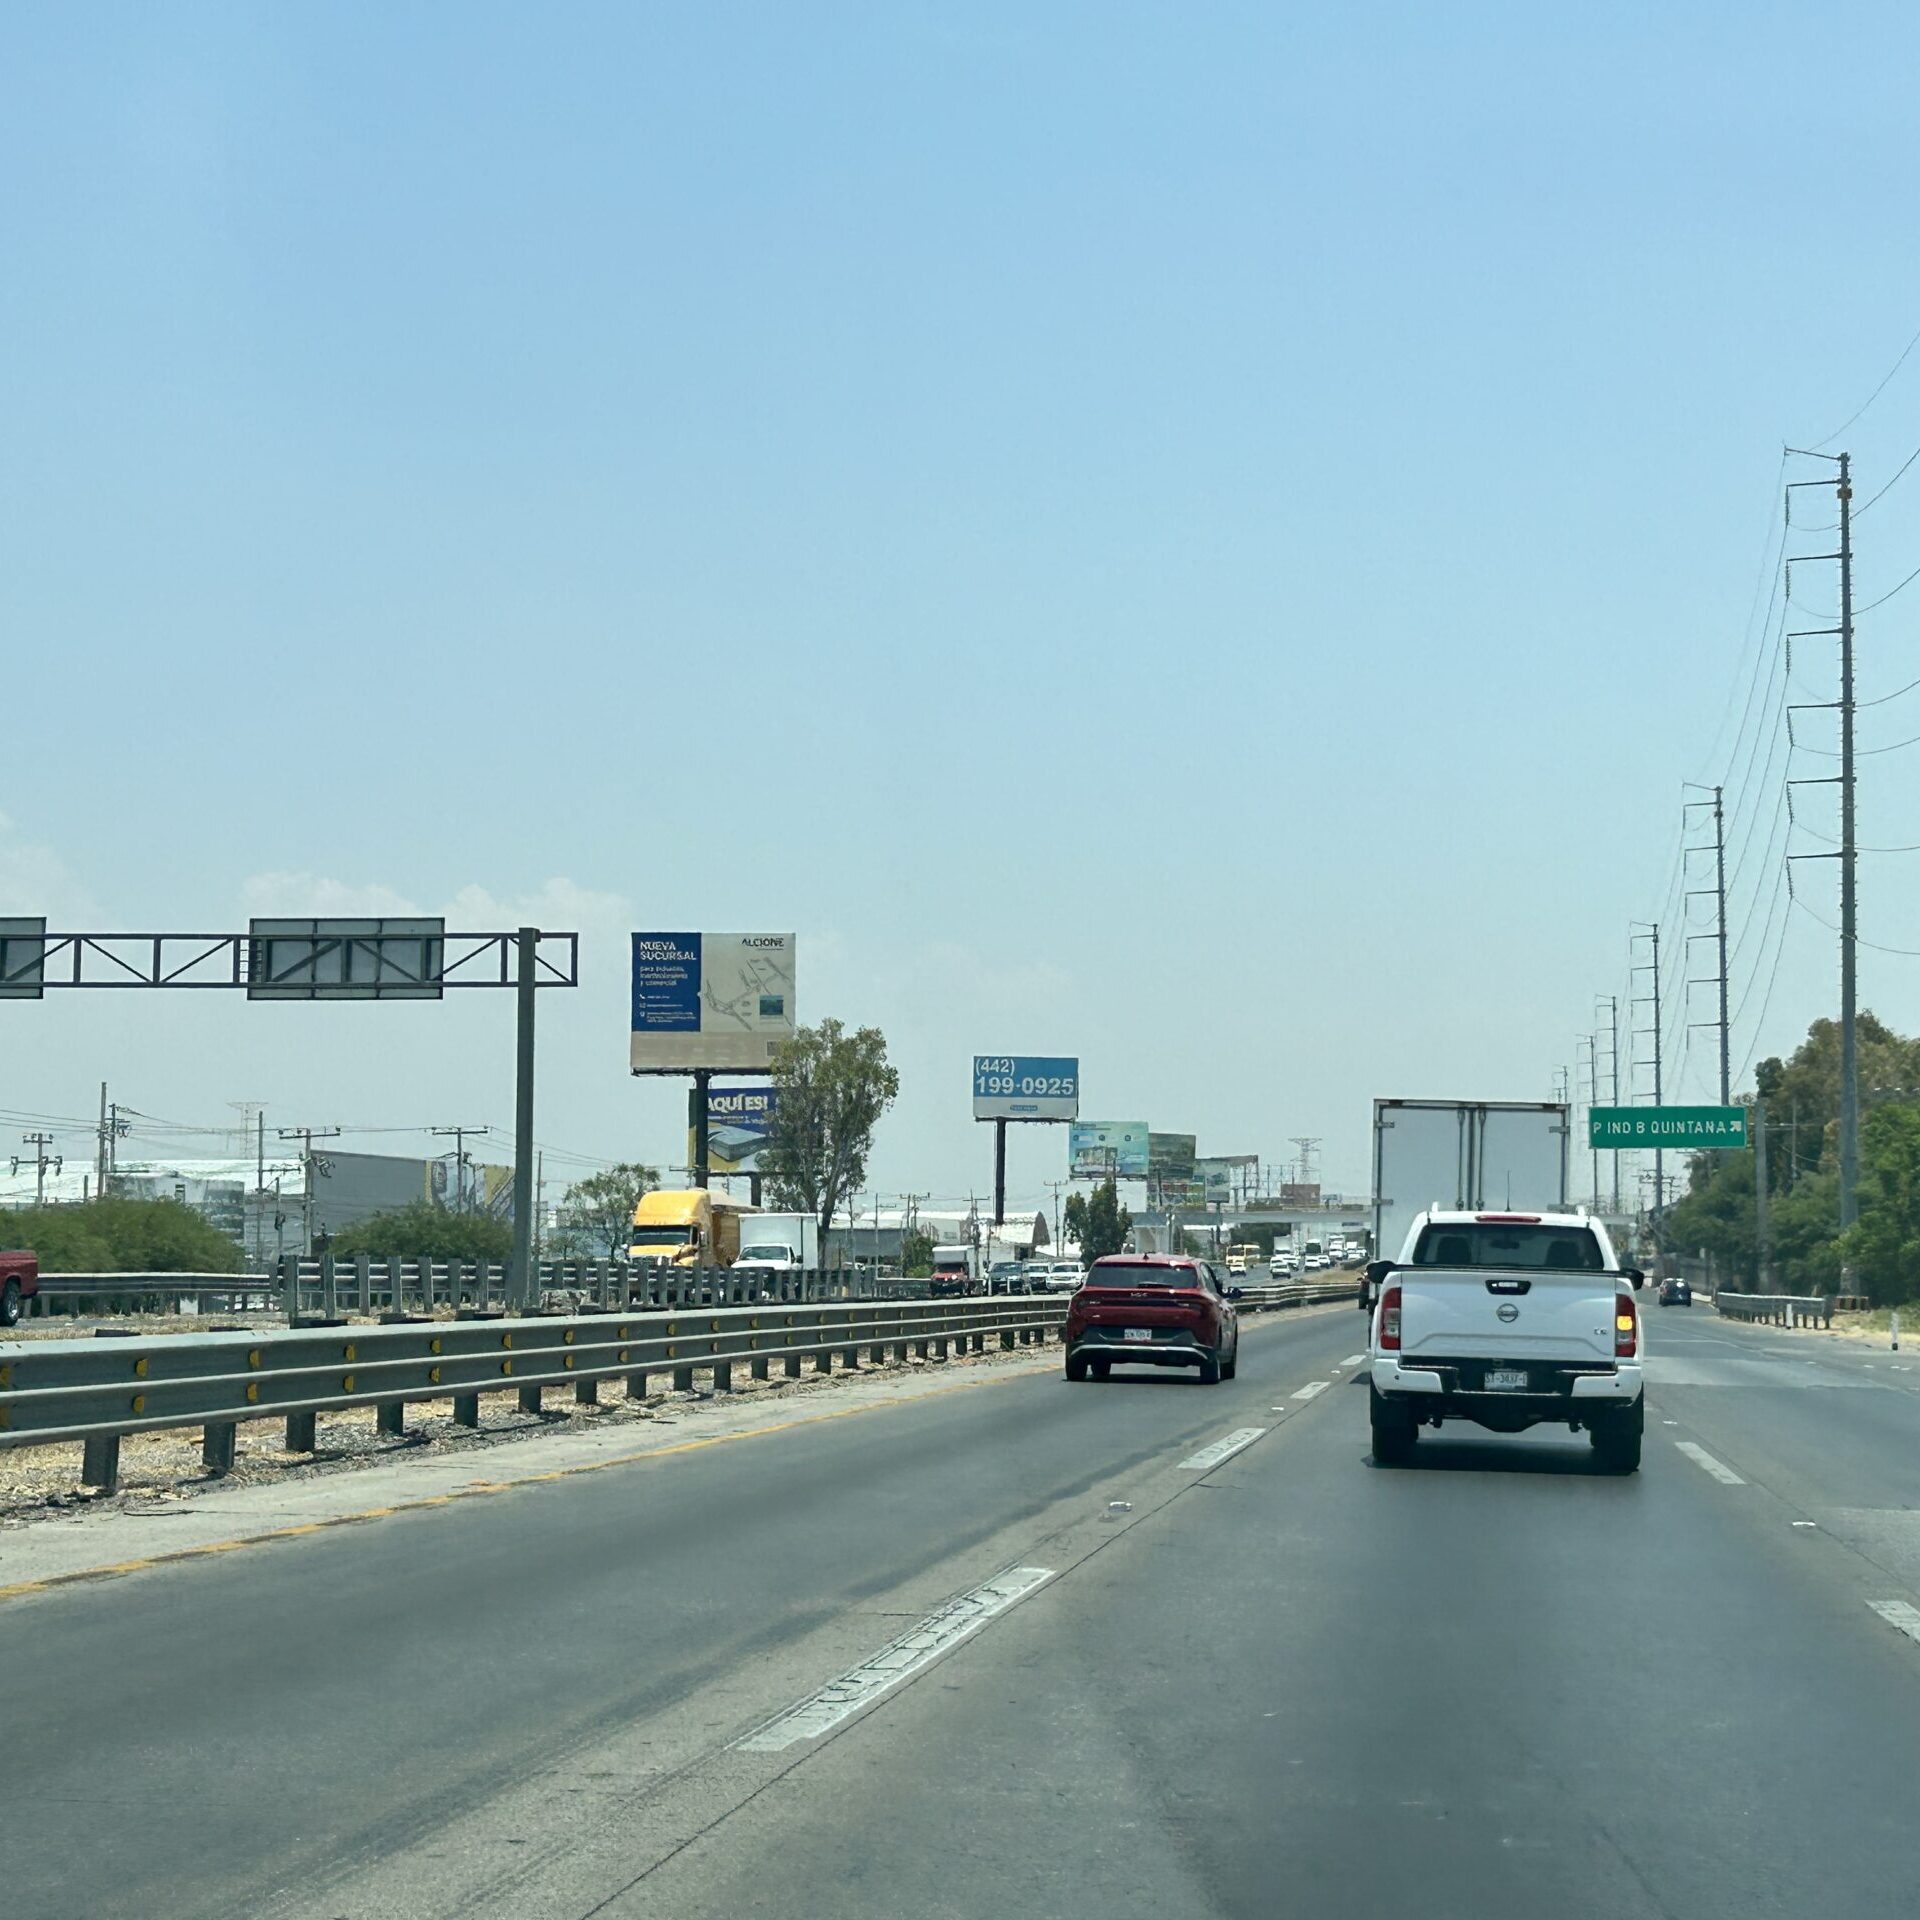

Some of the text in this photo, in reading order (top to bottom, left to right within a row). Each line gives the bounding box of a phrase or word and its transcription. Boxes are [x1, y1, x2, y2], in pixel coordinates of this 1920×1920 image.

[640, 941, 676, 951] NUEVA
[741, 937, 785, 947] ALCIONE
[640, 951, 697, 961] SUCURSAL
[975, 1058, 1016, 1076] (442)
[976, 1077, 1075, 1095] 199-0925
[745, 1095, 769, 1111] ES!
[1593, 1120, 1727, 1134] P IND B QUINTANA
